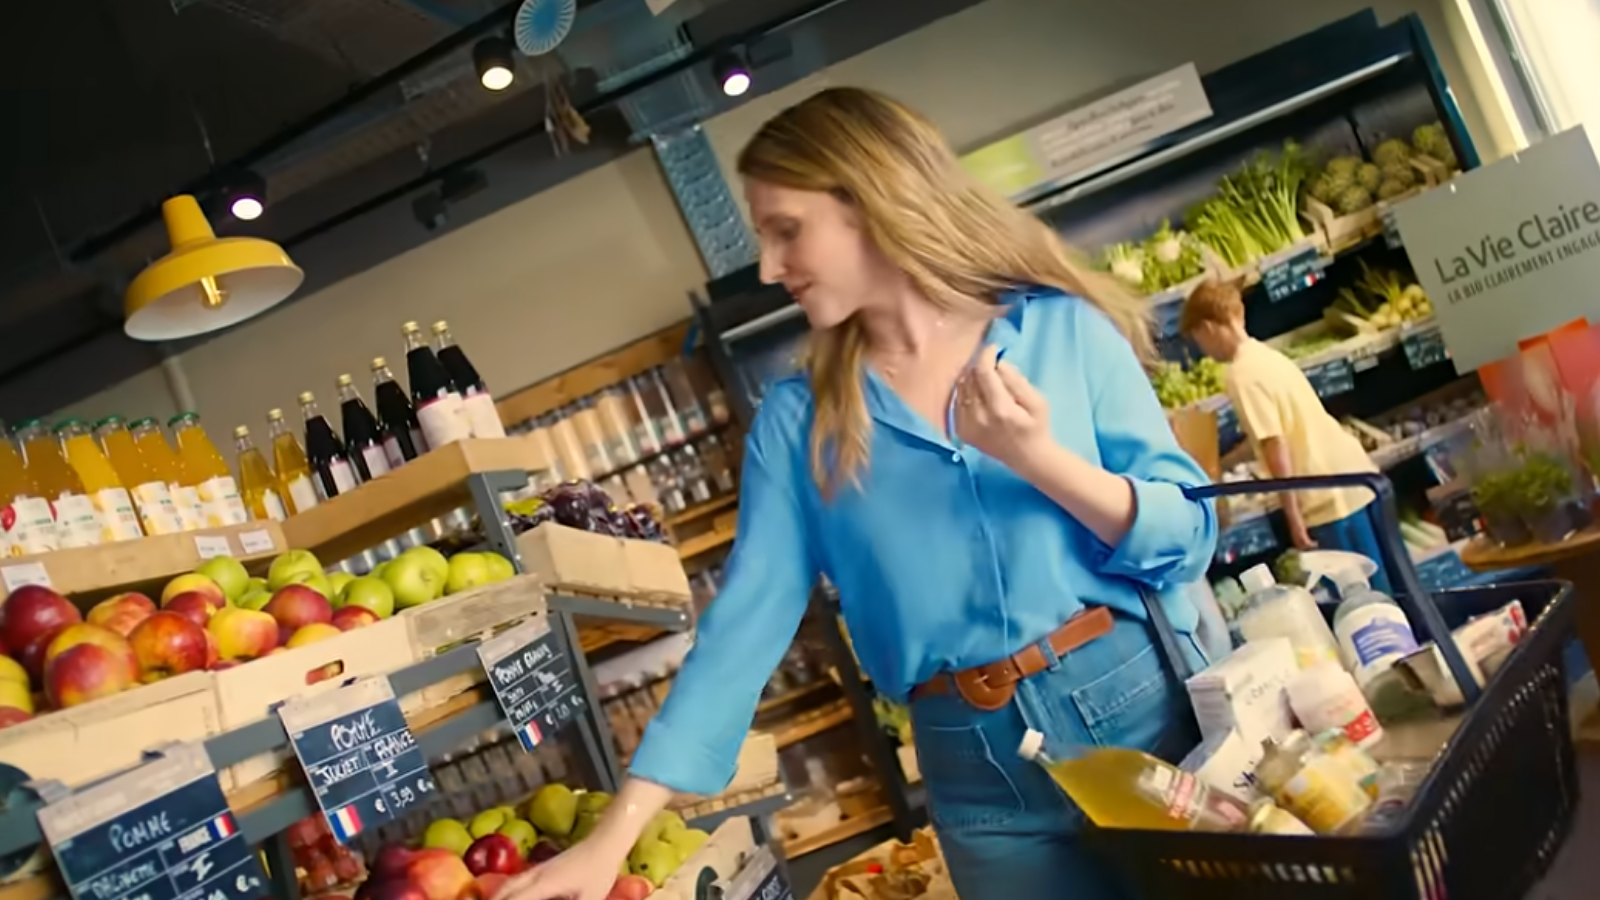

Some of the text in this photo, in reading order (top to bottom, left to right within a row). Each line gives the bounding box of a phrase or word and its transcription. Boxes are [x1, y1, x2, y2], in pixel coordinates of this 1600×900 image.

[1517, 201, 1600, 249] Claire
[1484, 251, 1555, 290] CLAIREMENT
[331, 708, 382, 750] POMME
[109, 811, 172, 853] POMME
